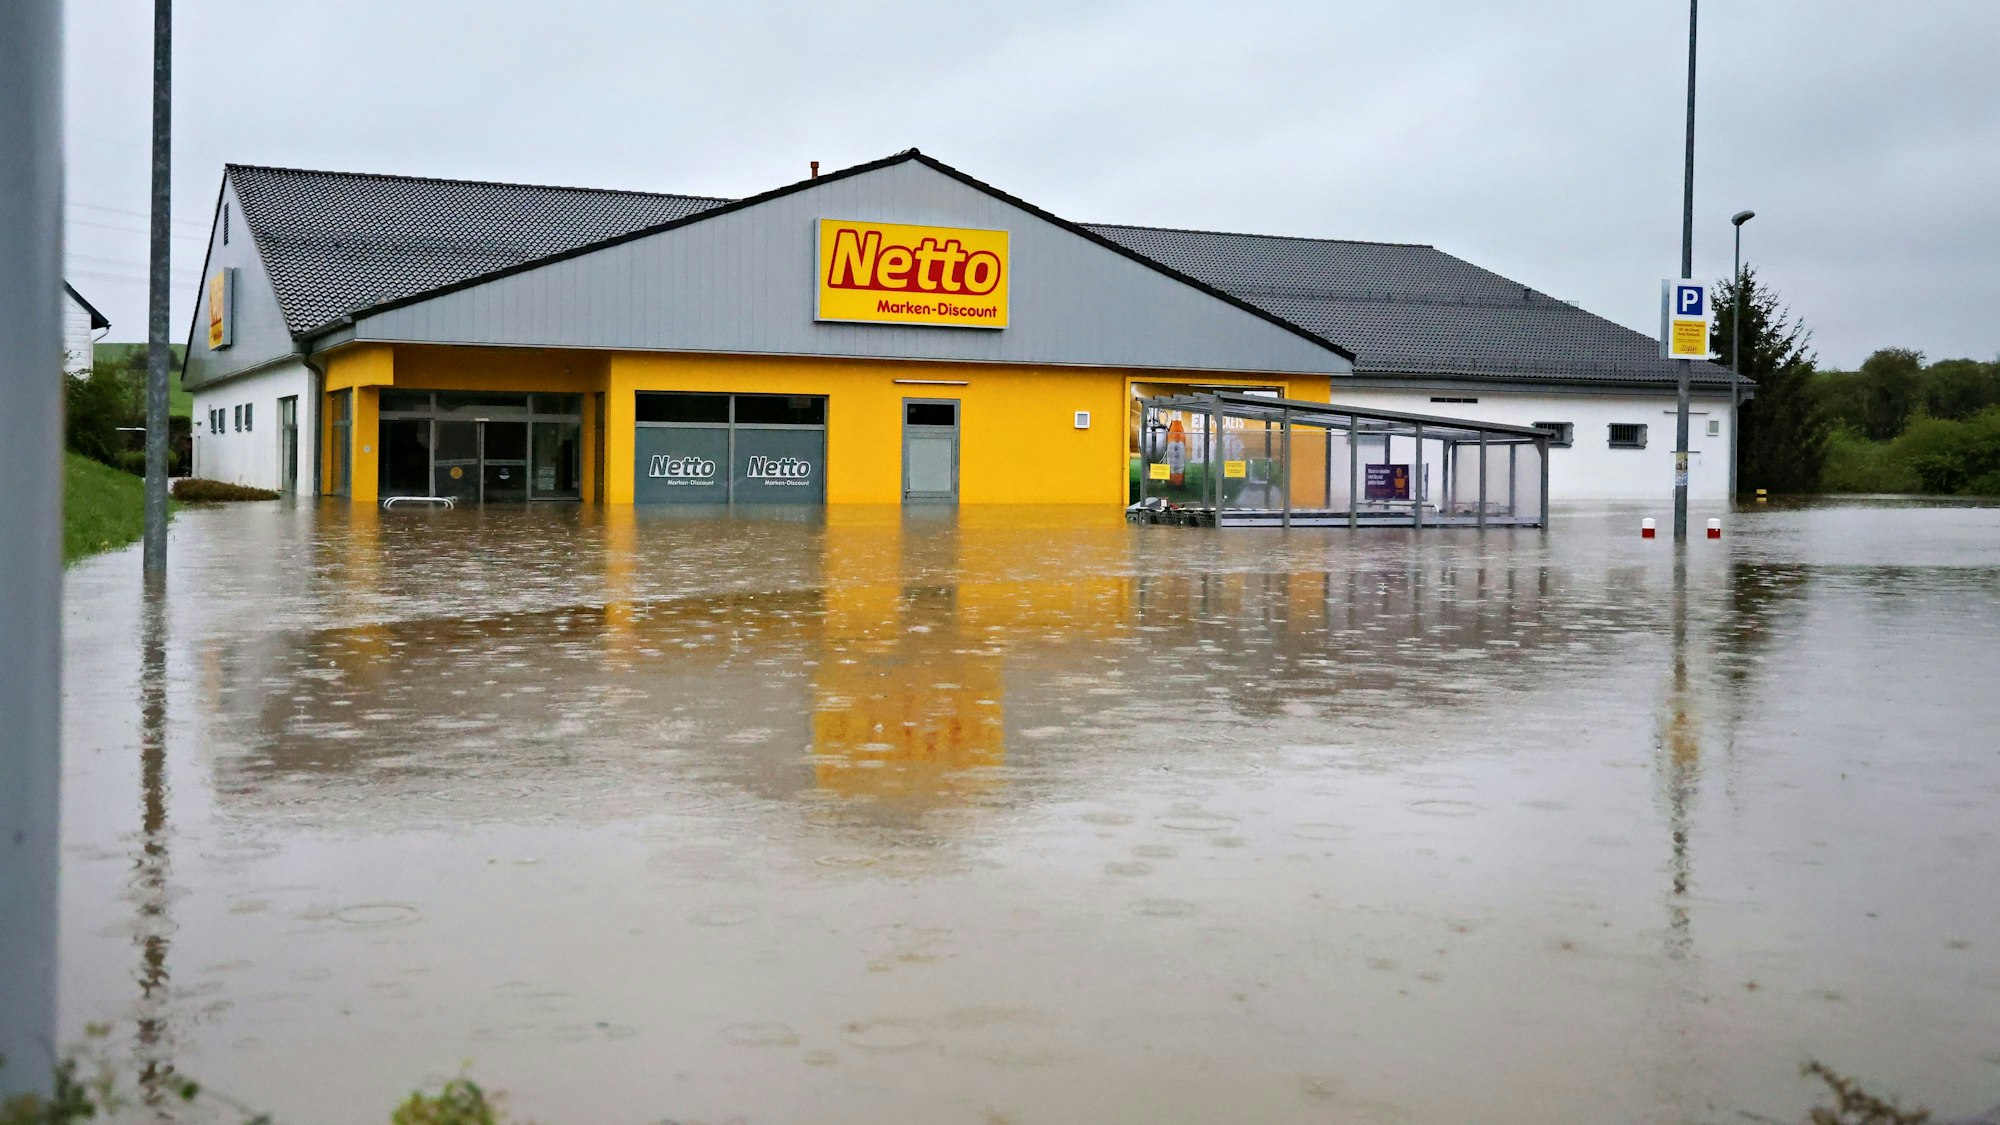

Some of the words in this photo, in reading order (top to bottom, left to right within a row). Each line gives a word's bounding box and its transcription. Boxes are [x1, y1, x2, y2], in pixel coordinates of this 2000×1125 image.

[828, 228, 1001, 296] Netto
[877, 300, 998, 318] Marken-Discount
[1682, 289, 1699, 312] P
[649, 454, 716, 478] Netto
[747, 455, 811, 478] Netto
